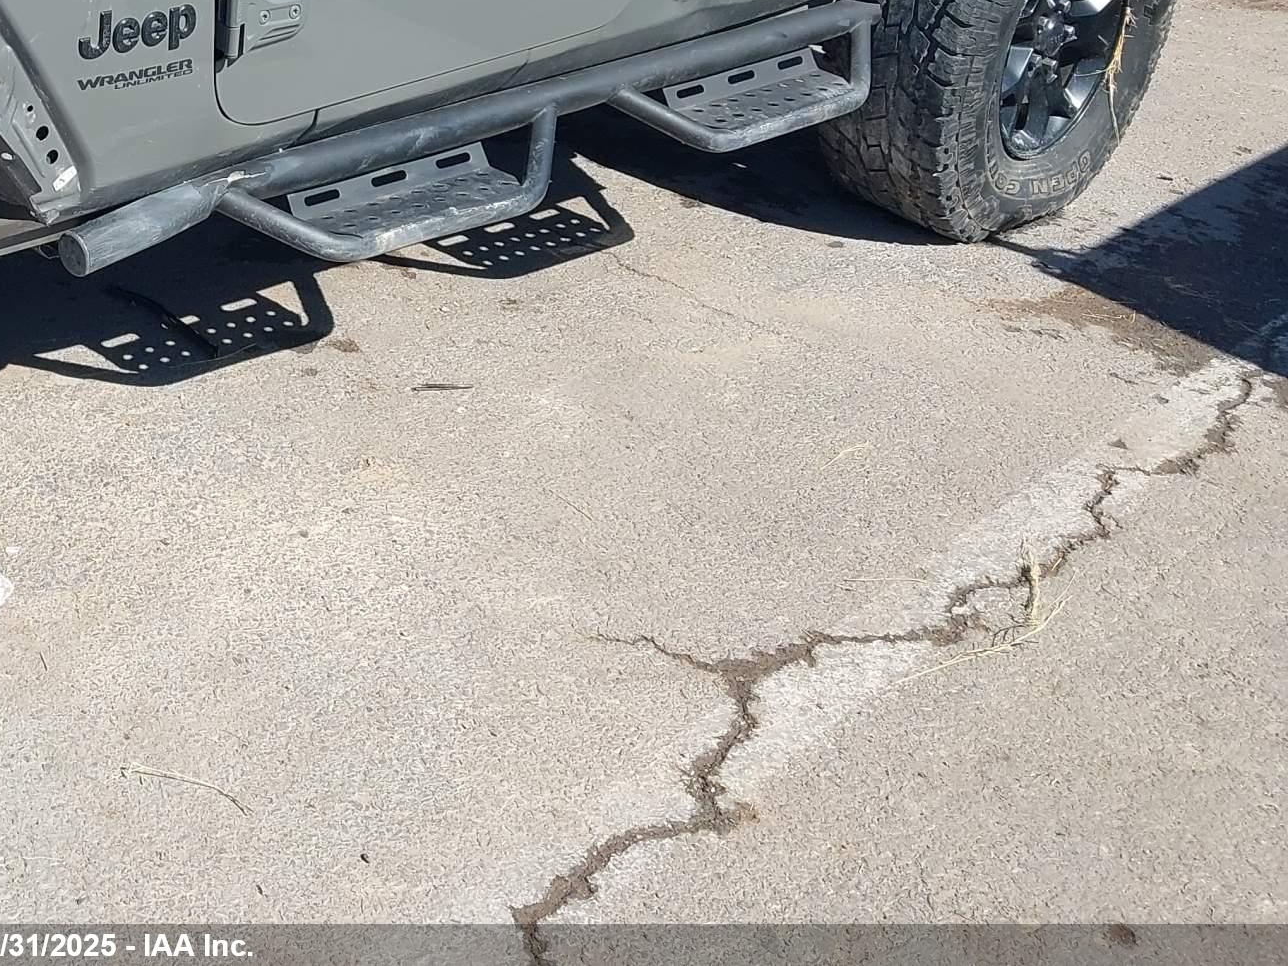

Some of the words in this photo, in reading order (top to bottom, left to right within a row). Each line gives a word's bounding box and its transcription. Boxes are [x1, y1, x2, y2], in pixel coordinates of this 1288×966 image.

[78, 3, 197, 60] Jeep
[76, 58, 193, 91] WRANGLER
[114, 68, 193, 91] UNLIMITED
[1029, 148, 1091, 196] OPEN
